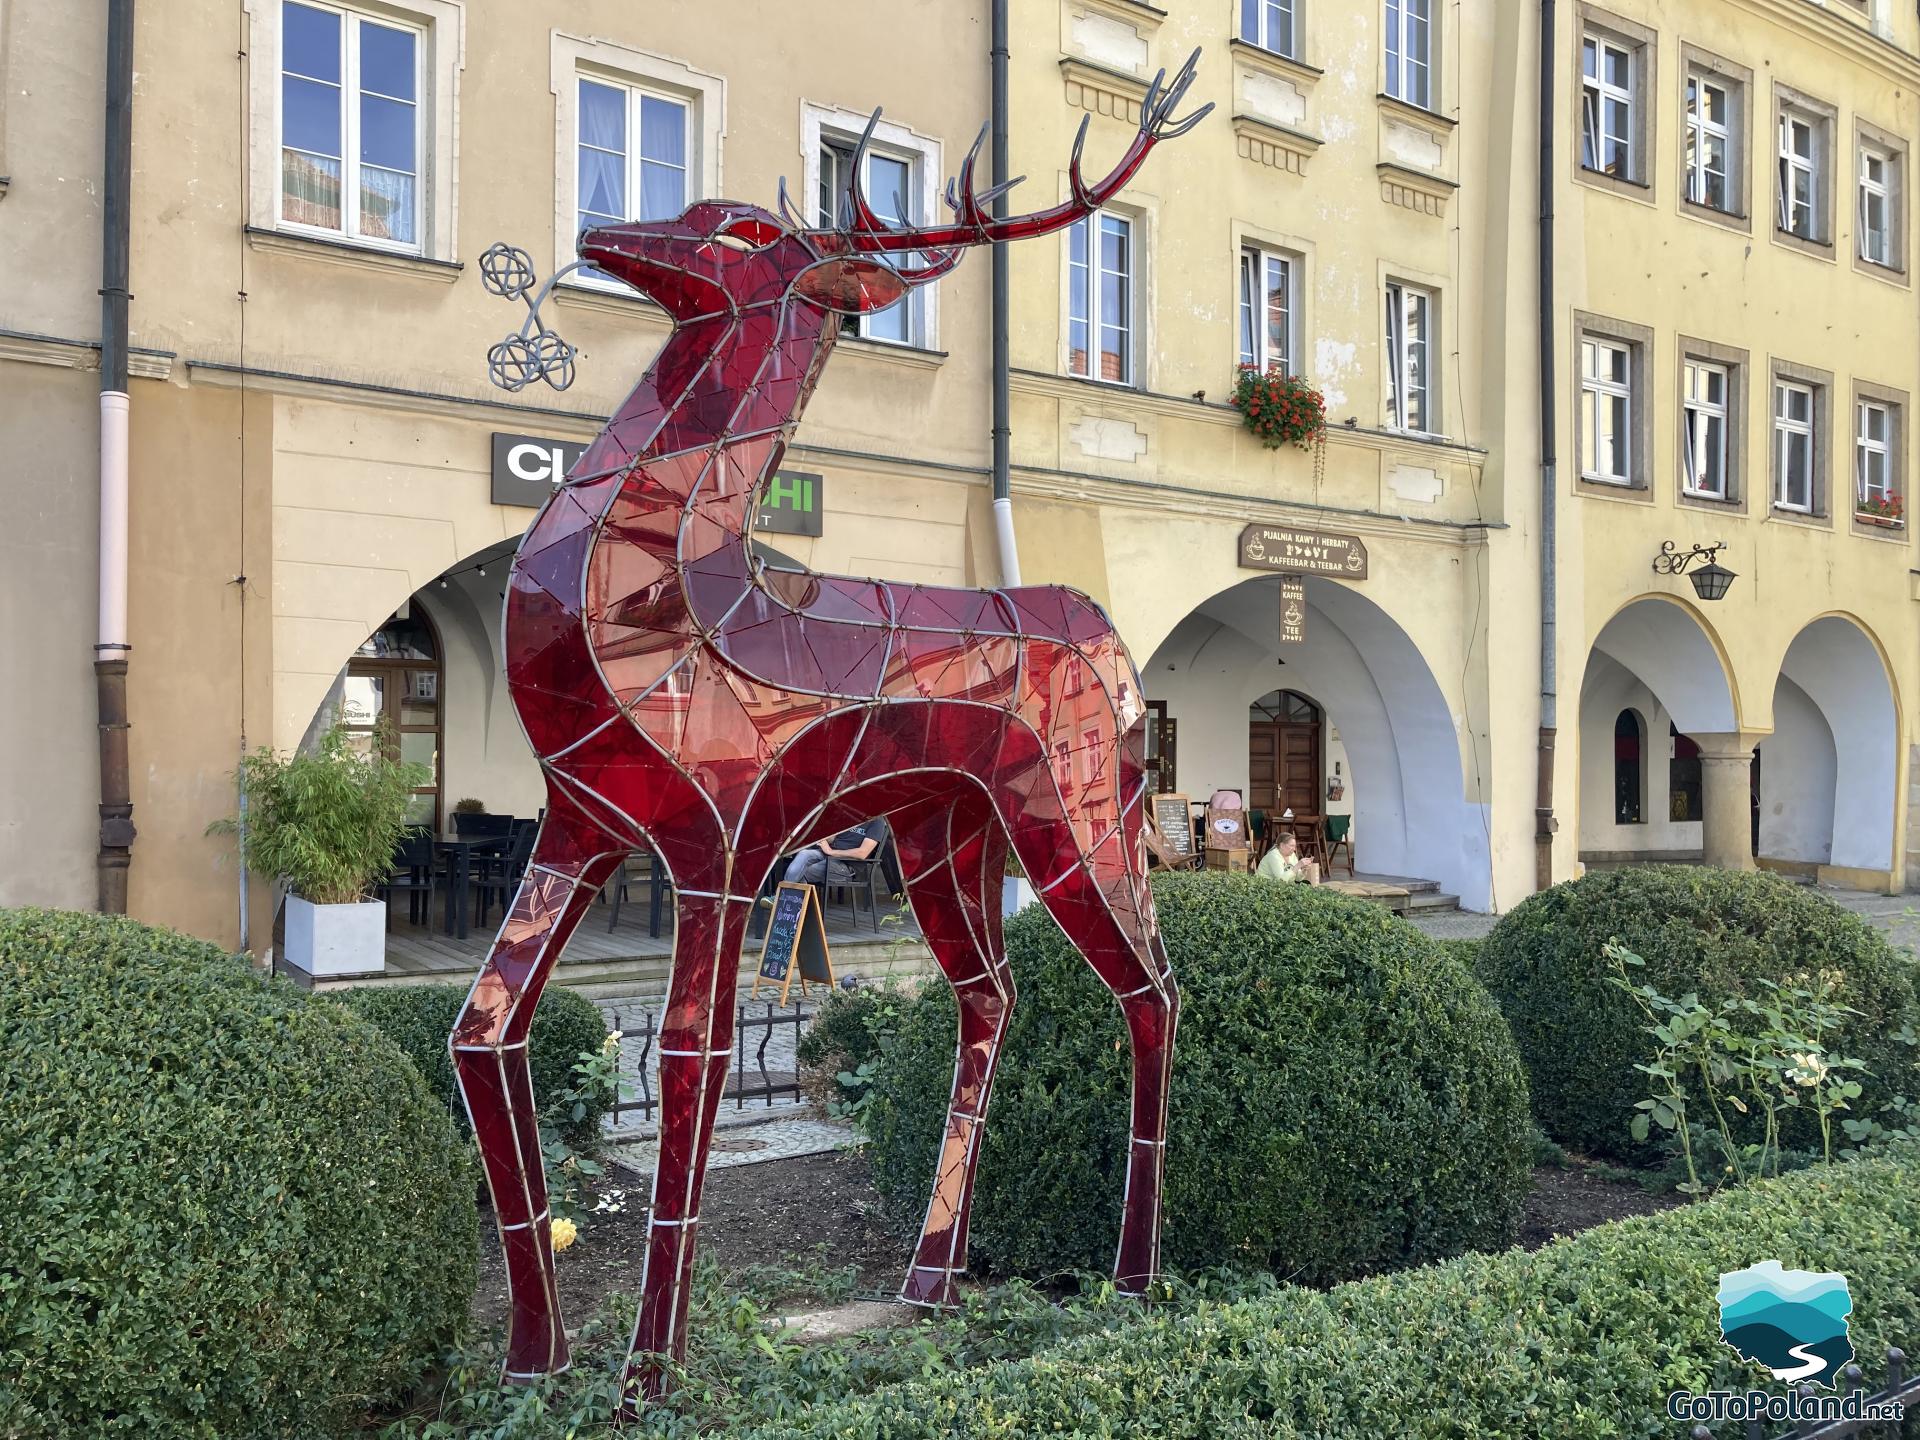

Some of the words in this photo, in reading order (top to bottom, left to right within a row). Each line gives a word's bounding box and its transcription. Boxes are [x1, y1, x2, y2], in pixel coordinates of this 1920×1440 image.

[1263, 530, 1293, 542] PIJALNIA
[1295, 534, 1314, 544] KAWY
[1321, 538, 1349, 549] HERBATY
[1268, 555, 1309, 568] KAFFEEBAR
[1309, 560, 1316, 568] &
[1317, 561, 1343, 571] TEEBAR
[1282, 592, 1303, 600] KAFFEE
[1285, 626, 1300, 635] TEE
